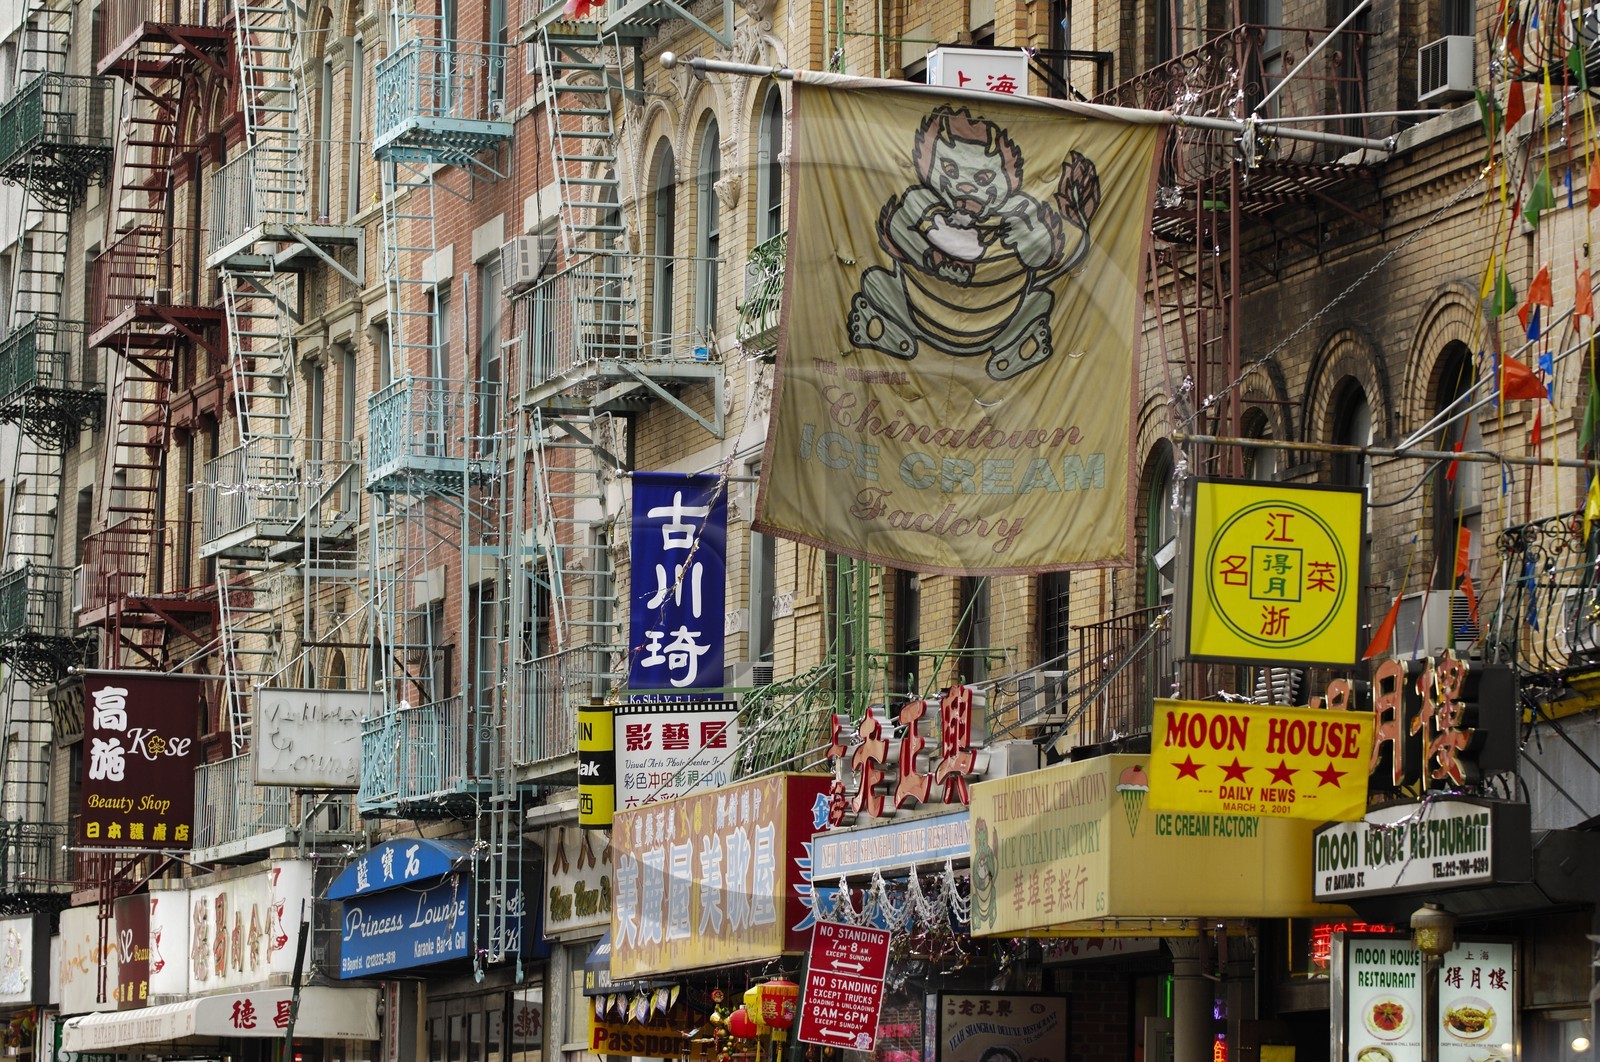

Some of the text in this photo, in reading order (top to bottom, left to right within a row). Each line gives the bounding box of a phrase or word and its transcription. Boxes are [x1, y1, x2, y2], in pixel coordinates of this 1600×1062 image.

[845, 366, 910, 386] RIGINAL
[823, 385, 1084, 450] Chinatown
[800, 424, 1105, 495] ICE CREAM
[850, 487, 1024, 553] Factory
[1265, 513, 1294, 542] 江
[1219, 555, 1248, 586] 名
[1307, 561, 1336, 592] 菜
[626, 721, 727, 752] 影藝屋
[1164, 711, 1360, 759] MOON HOUSE
[625, 759, 646, 769] Visual
[648, 758, 664, 768] Arts
[88, 794, 170, 815] Beauty Shop
[992, 771, 1108, 822] THE ORIGINAL CHINATOWN
[1219, 785, 1296, 804] DAILY NEWS
[1223, 802, 1256, 813] MARCH
[1271, 804, 1292, 814] 2001
[1155, 815, 1259, 838] ICE CREAM FACTORY
[822, 843, 838, 869] NEW
[860, 832, 896, 863] SHANGHAI
[897, 828, 926, 856] DELUXE
[927, 819, 970, 851] RESTAURAN
[1001, 819, 1101, 869] ICE CREAM FACTORY
[1318, 831, 1358, 872] MOON
[1410, 813, 1489, 860] RESTAURANT
[343, 907, 404, 942] Princess
[409, 891, 466, 930] Lounge
[414, 938, 434, 958] Karaoke
[455, 931, 466, 950] Grill
[820, 925, 885, 945] NO STANDING
[825, 950, 872, 962] EXCEPT SUNDAY
[1355, 948, 1420, 967] MOON HOUSE
[1465, 950, 1489, 961] 上海
[812, 976, 878, 995] NO STANDING
[1358, 971, 1416, 989] RESTAURANT
[809, 998, 834, 1007] LOADING
[841, 1002, 875, 1013] UNLOADING
[813, 989, 873, 1005] EXCEPT TRUCKS
[812, 1006, 869, 1024] 8AM-6PM
[814, 1017, 864, 1031] EXCEPT SUNDAY
